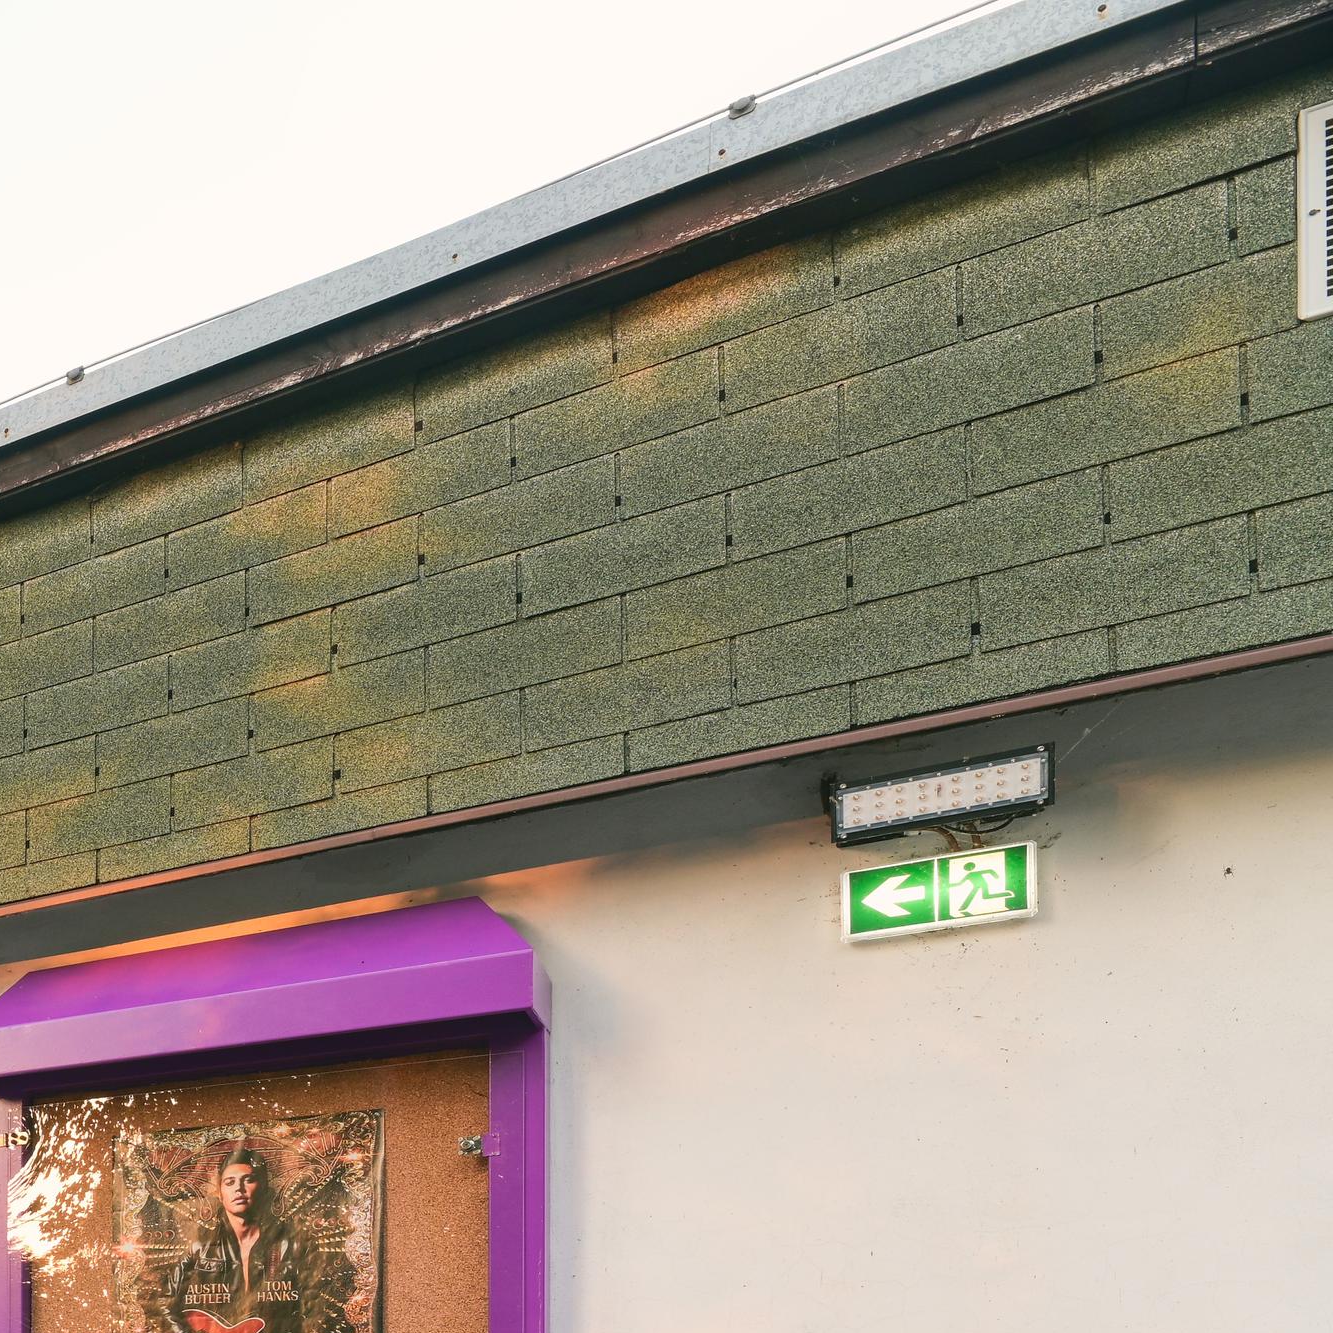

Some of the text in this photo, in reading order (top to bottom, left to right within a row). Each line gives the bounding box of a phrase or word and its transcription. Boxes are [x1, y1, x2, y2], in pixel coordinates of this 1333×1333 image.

[186, 1283, 230, 1295] AUSTIN
[265, 1281, 292, 1291] TOM
[184, 1294, 231, 1305] BUTLER
[257, 1291, 299, 1302] HANKS
